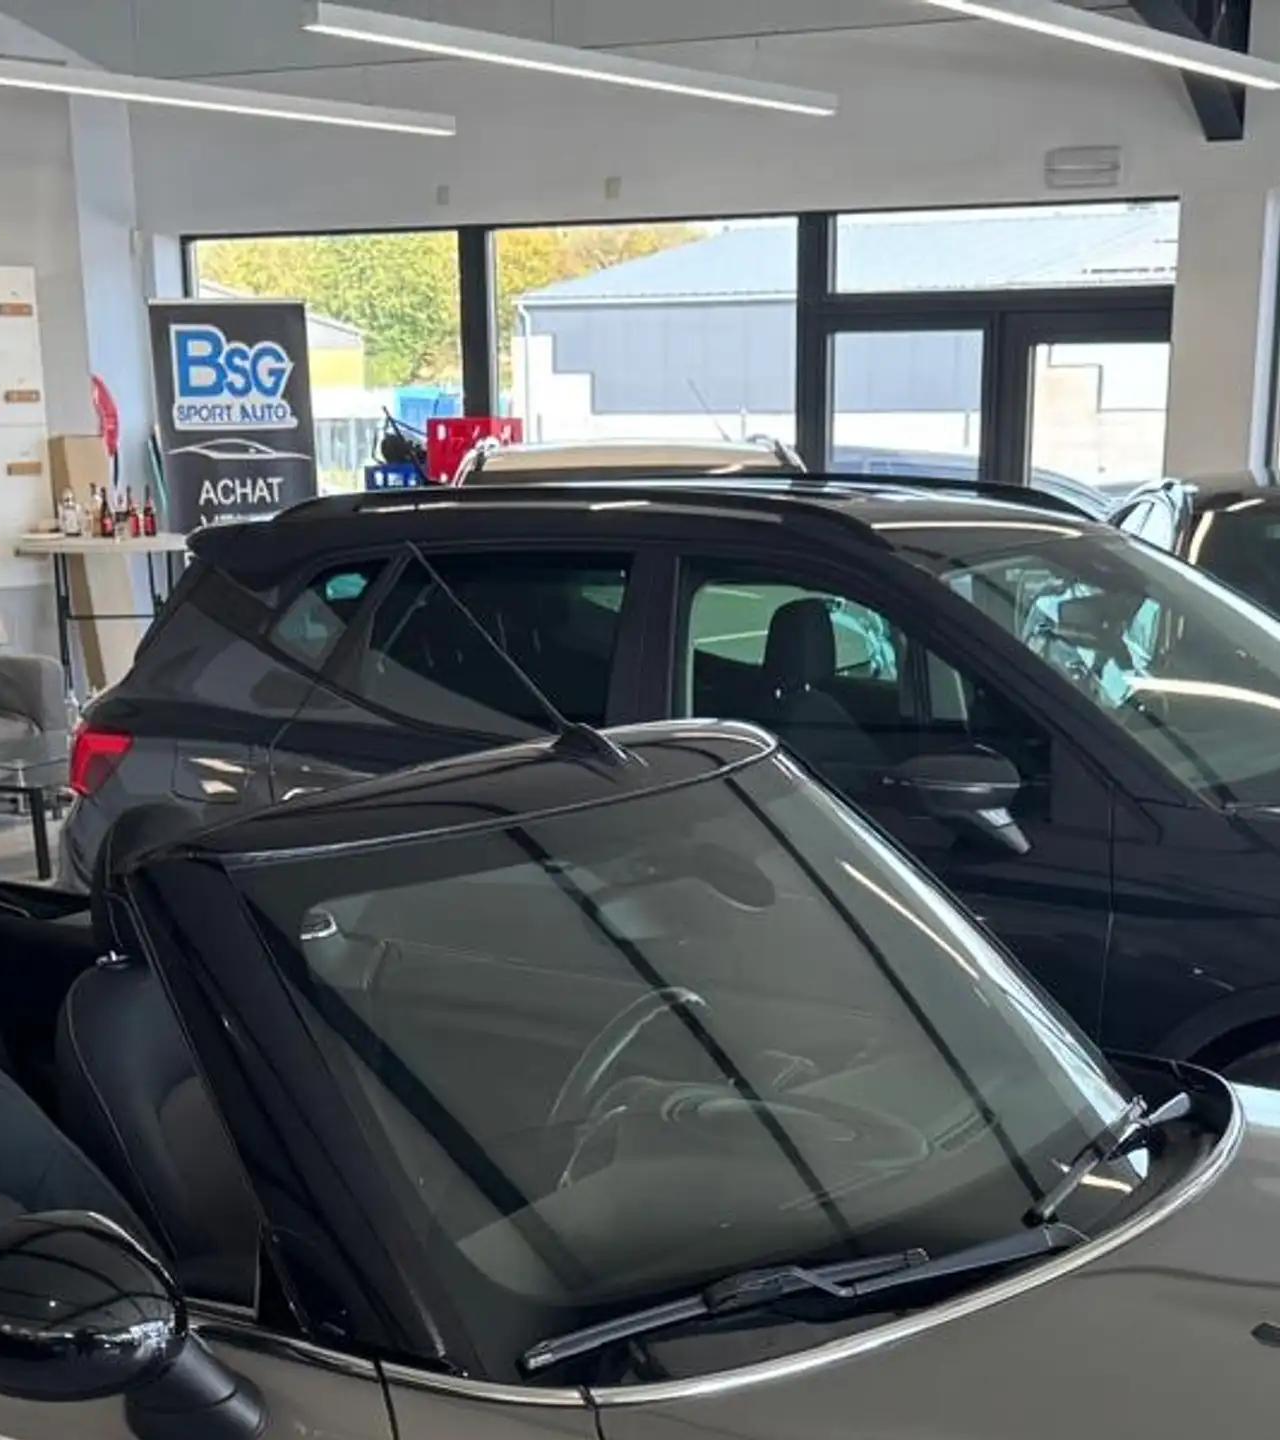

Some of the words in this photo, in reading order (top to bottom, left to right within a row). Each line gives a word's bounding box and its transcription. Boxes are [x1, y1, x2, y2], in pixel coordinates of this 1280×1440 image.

[177, 402, 231, 421] SPORT
[240, 403, 288, 420] AUTO
[199, 478, 283, 505] ACHAT
